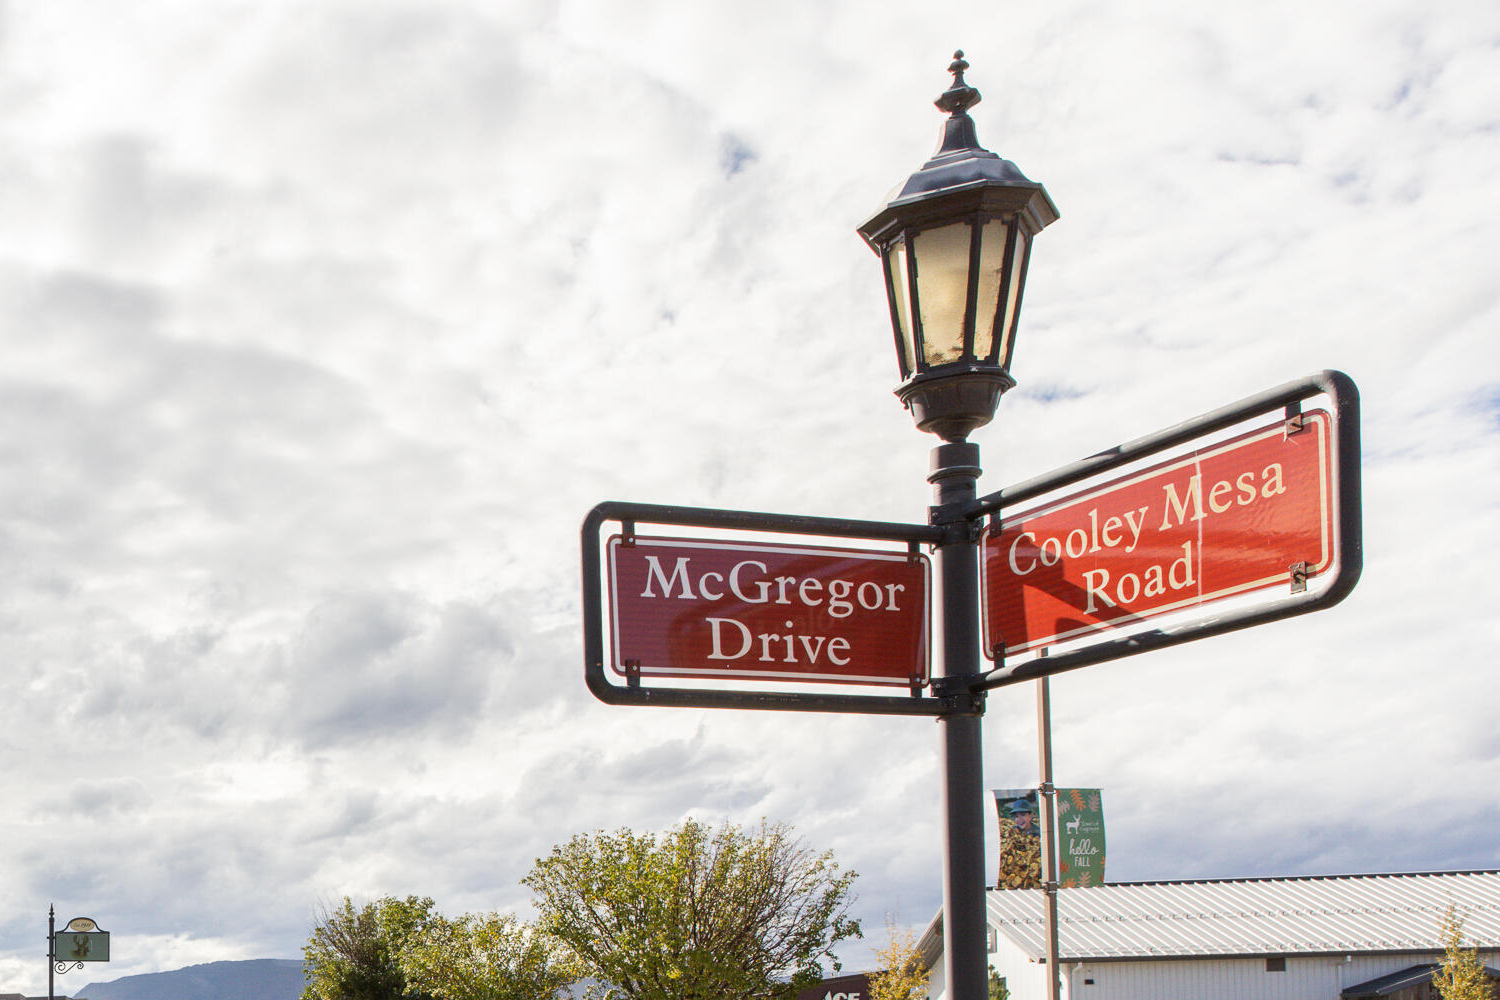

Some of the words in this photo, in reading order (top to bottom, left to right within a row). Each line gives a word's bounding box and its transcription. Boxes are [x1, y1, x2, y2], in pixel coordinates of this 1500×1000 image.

[1008, 508, 1149, 577] Cooley
[1158, 461, 1287, 532] Mesa
[639, 555, 906, 618] McGregor
[1081, 540, 1197, 616] Road
[705, 617, 852, 666] Drive
[1069, 838, 1100, 855] hello
[1074, 856, 1091, 867] FALL
